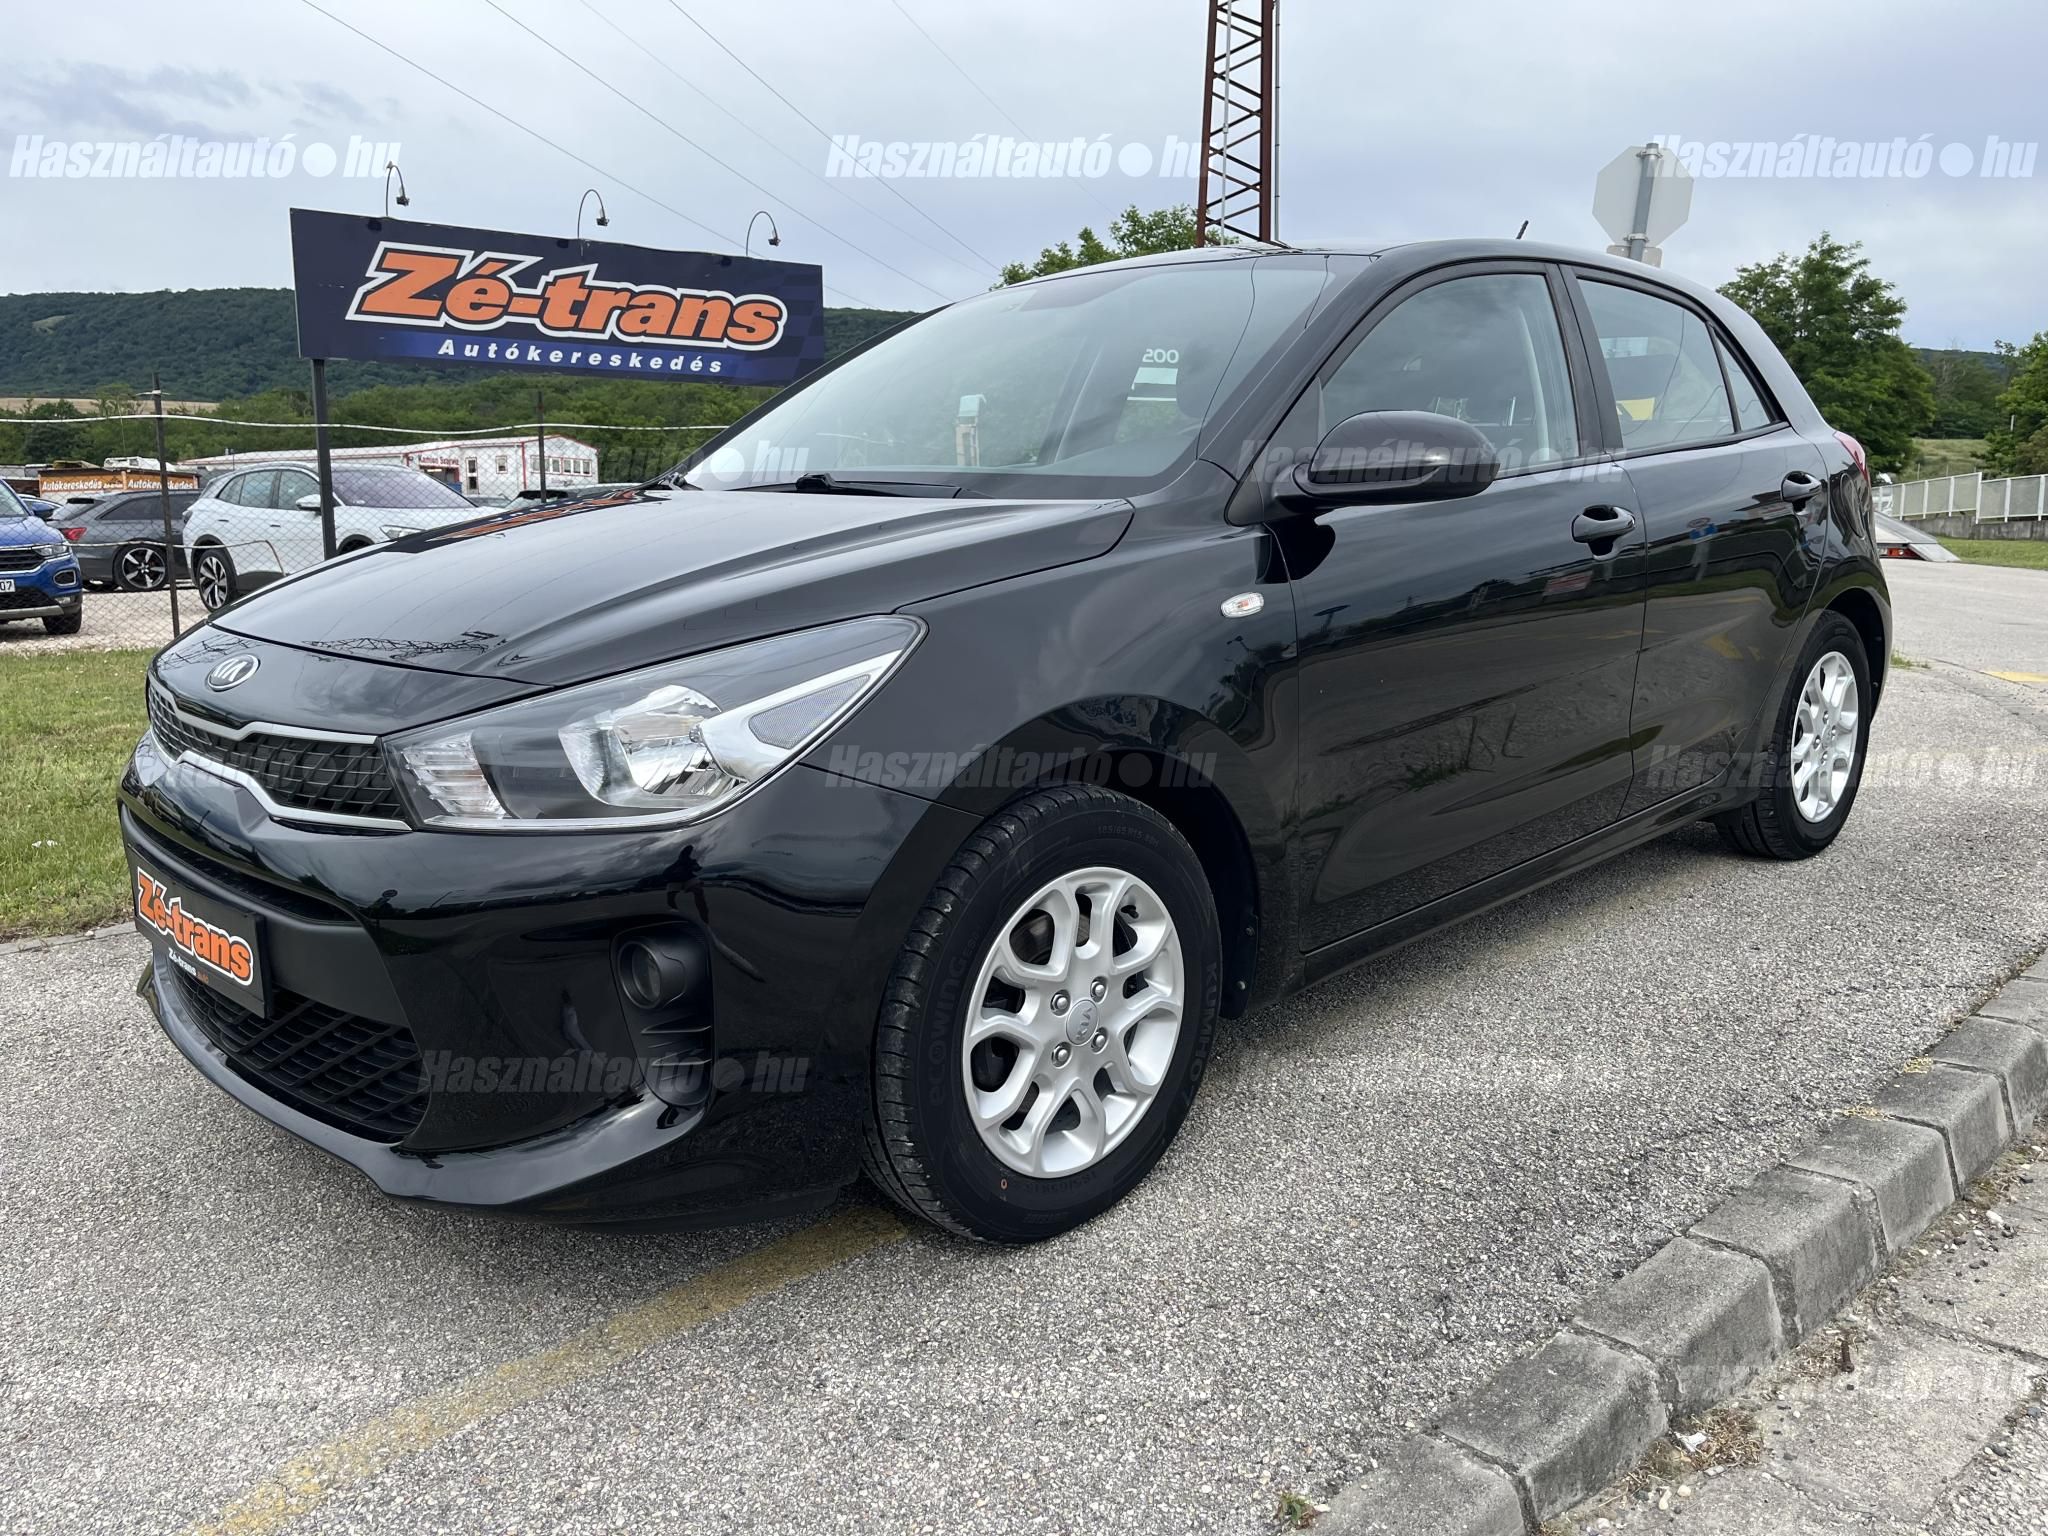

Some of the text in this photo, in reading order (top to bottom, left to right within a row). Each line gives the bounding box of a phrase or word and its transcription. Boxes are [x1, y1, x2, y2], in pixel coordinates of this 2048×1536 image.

[345, 241, 788, 351] Zé-trans
[438, 339, 722, 373] Autókereskedés
[1142, 349, 1179, 363] 200
[128, 480, 193, 490] Autókerkedés
[138, 866, 253, 986] Zé-trans
